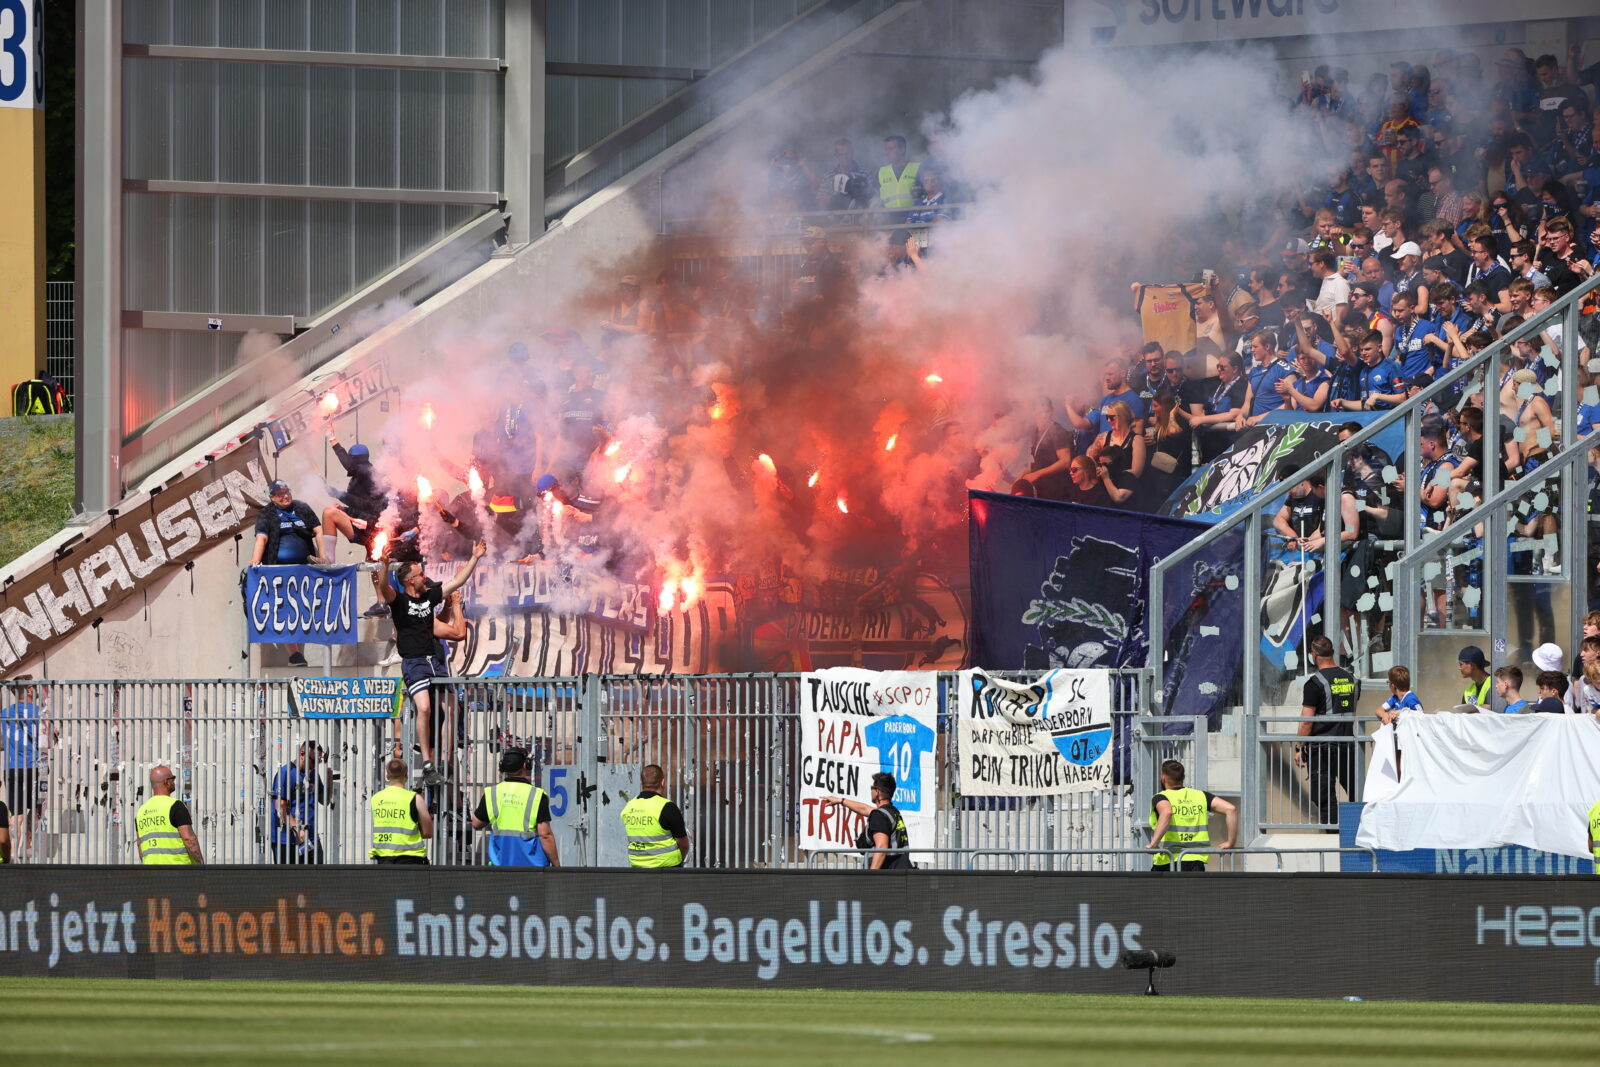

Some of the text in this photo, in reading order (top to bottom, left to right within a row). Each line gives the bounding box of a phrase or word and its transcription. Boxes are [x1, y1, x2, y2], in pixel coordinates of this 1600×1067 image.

[0, 0, 26, 101] 3
[345, 363, 385, 406] 1907
[251, 575, 351, 633] GESSELN
[786, 611, 892, 640] PADERBRN
[297, 679, 396, 695] SCHNAPS & WEED
[302, 696, 394, 714] AUSWÄRTSSIEG!
[808, 678, 875, 716] TAUSCHE
[1068, 678, 1086, 703] SC
[818, 719, 863, 757] PAPA
[1032, 707, 1093, 732] PADERBORN
[889, 741, 912, 782] 10
[1071, 738, 1089, 761] 07
[803, 755, 859, 797] GEGEN
[972, 754, 1003, 786] DEIN
[1009, 752, 1060, 789] TRIKOT
[550, 768, 568, 817] 5
[374, 808, 406, 820] RDNER
[803, 798, 867, 848] TRIKO
[48, 892, 137, 968] jetzt
[148, 894, 385, 956] HeinerLiner.
[396, 895, 669, 962] Emissionslos.
[683, 900, 929, 980] Bargeldlos.
[943, 904, 1143, 968] Stresslos
